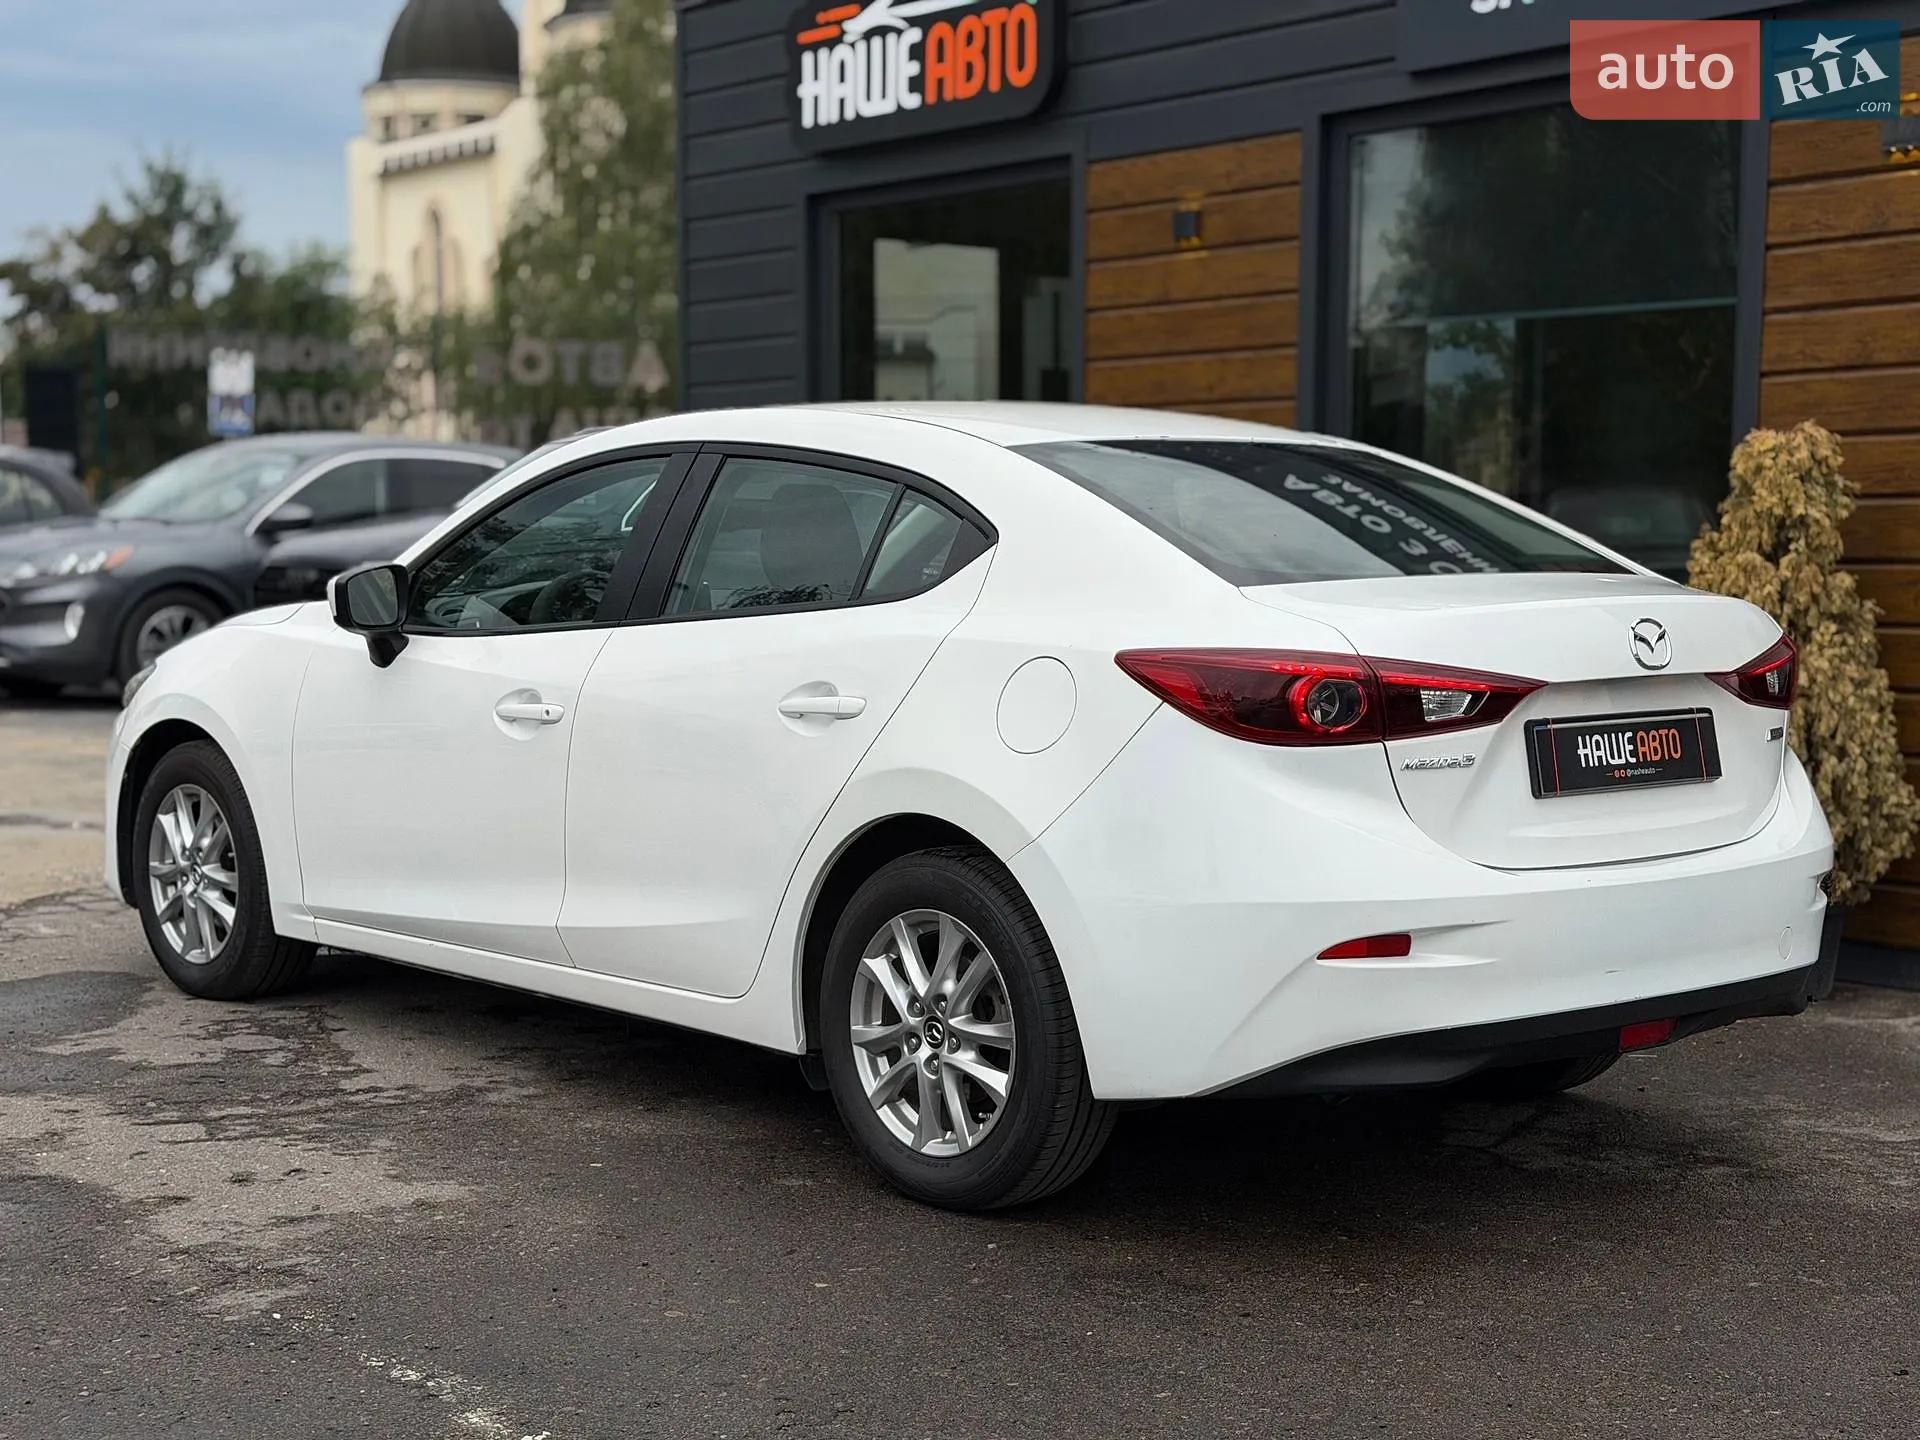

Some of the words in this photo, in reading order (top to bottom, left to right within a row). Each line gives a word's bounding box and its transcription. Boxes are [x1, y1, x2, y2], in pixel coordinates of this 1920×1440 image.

[797, 26, 923, 129] НАШЕ
[924, 2, 1038, 105] АВТО
[1577, 731, 1637, 768] НАШЕ
[1636, 728, 1682, 762] АВТО
